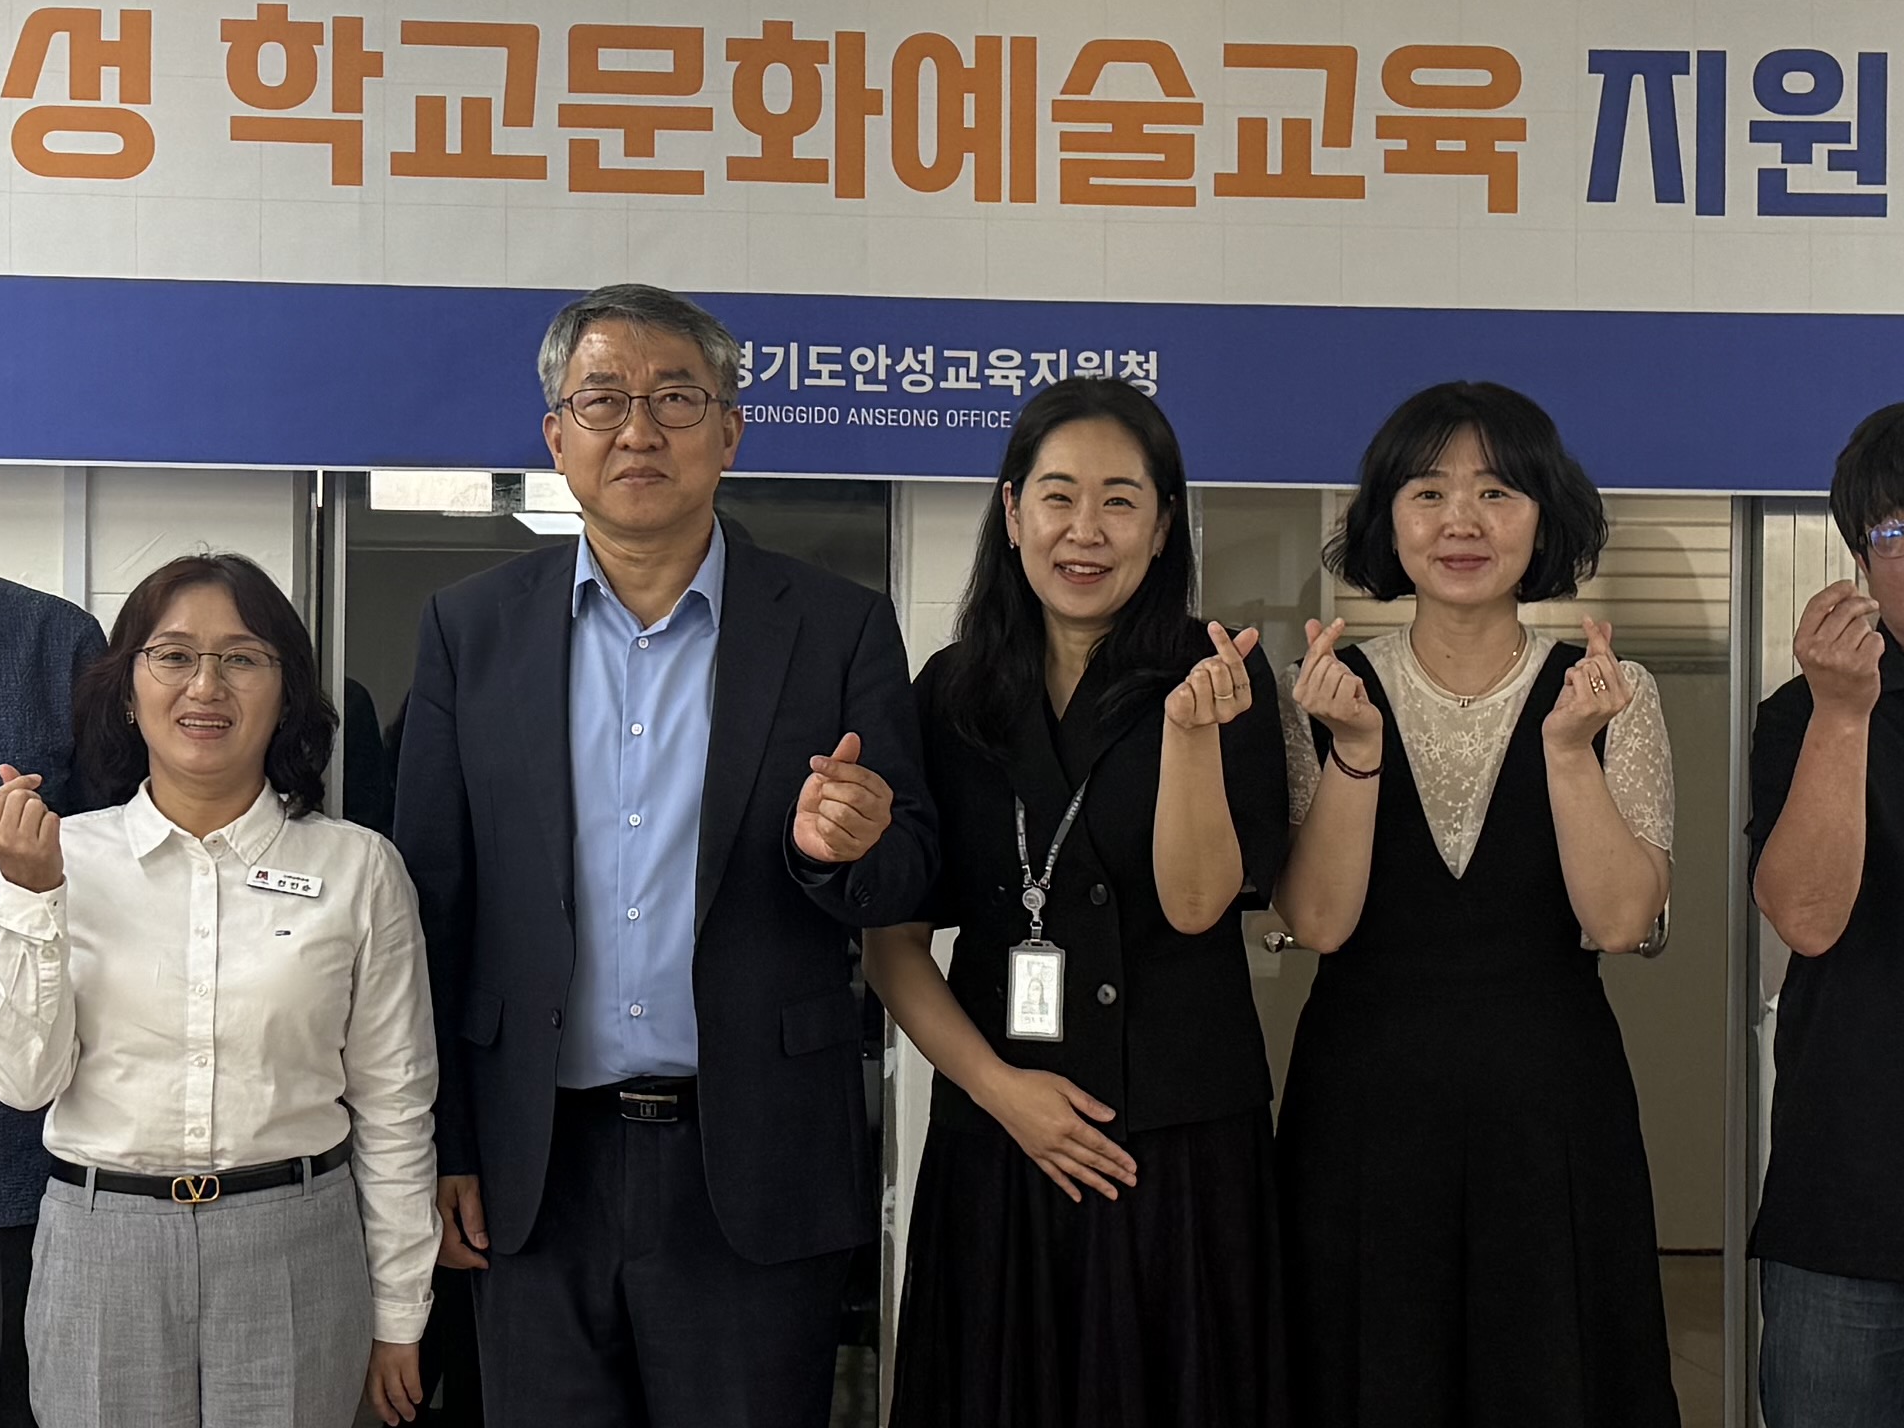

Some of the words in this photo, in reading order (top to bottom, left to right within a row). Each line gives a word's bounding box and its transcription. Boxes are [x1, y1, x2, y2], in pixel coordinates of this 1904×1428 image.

[219, 2, 1528, 215] 학교문화예술교육
[738, 404, 840, 425] EONGGIDO
[847, 407, 939, 427] ANSEONG
[946, 409, 1012, 429] OFFICE
